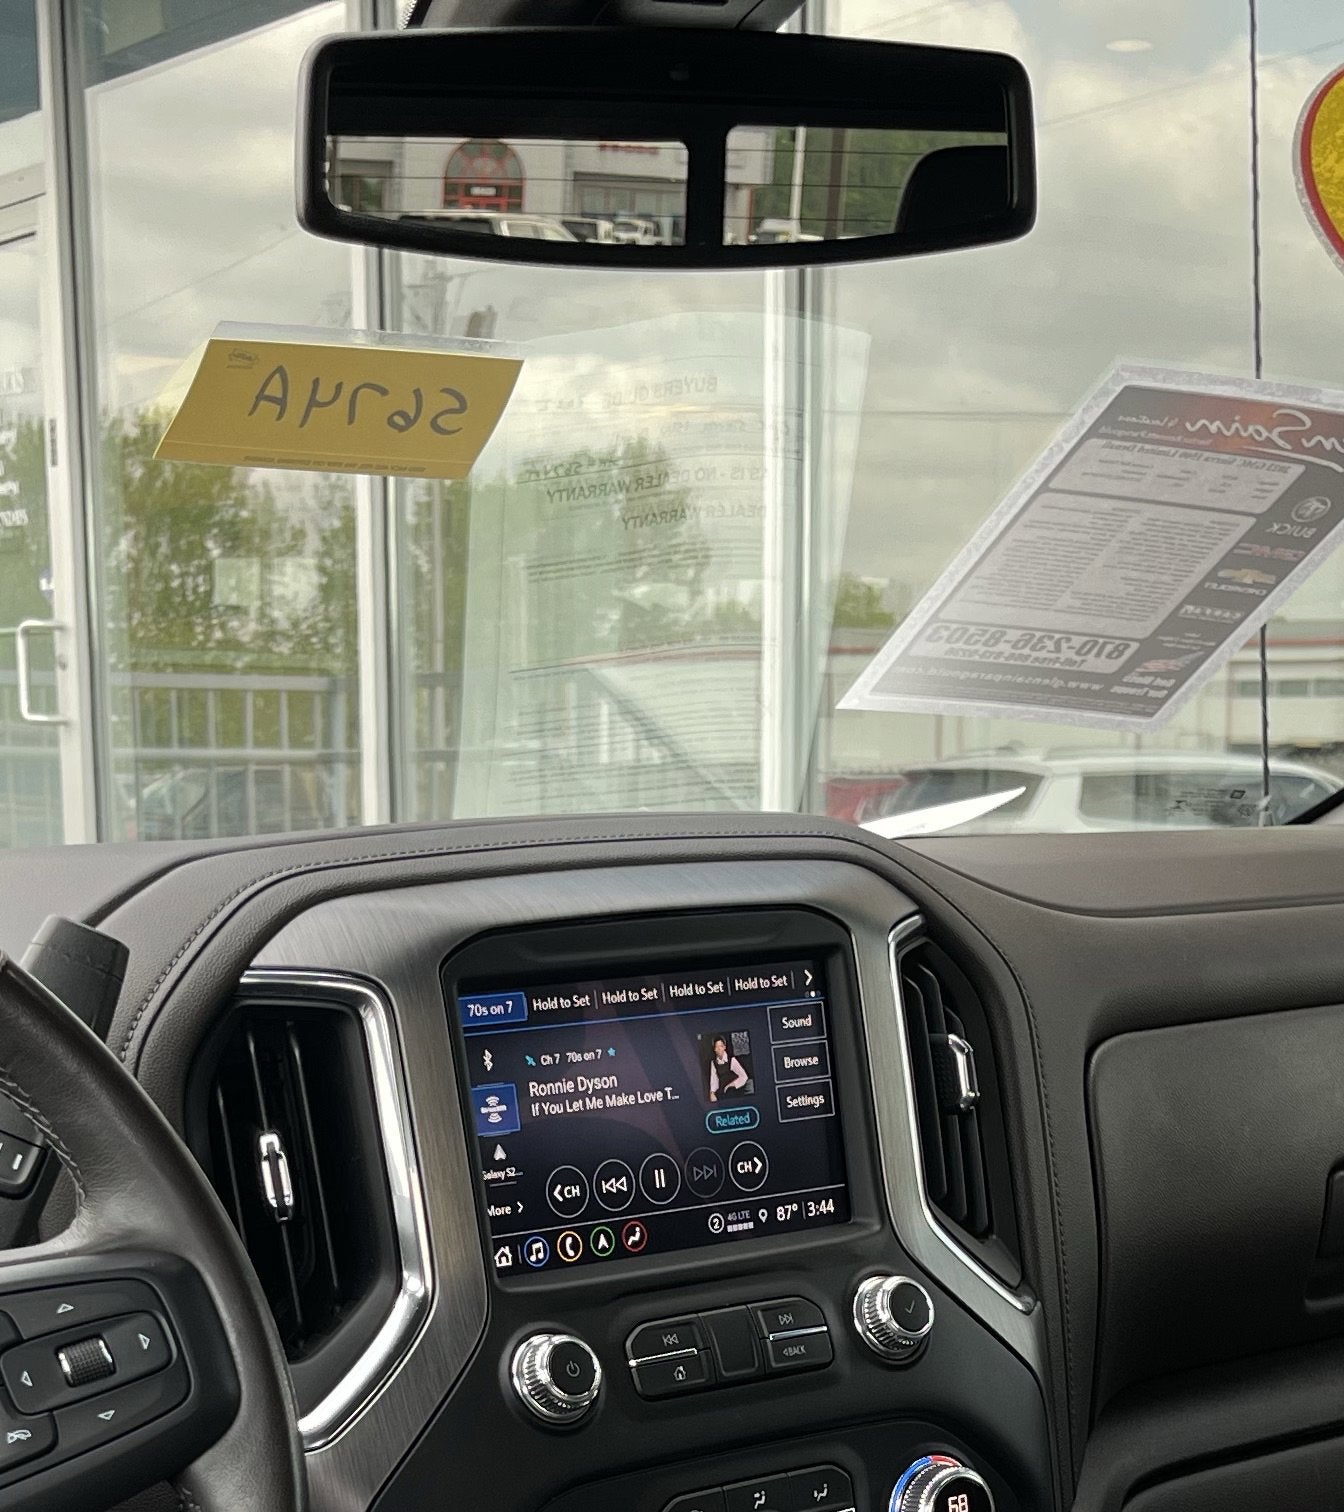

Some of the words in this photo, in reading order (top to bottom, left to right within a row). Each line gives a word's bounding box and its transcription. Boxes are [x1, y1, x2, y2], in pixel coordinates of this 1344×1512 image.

[669, 982, 694, 998] Hold
[695, 983, 706, 996] to
[706, 980, 724, 994] Set
[734, 976, 758, 991] Hold
[759, 976, 770, 989] to
[771, 975, 788, 988] Set
[532, 996, 558, 1012] Hold
[559, 997, 572, 1010] to
[573, 994, 591, 1008] Set
[601, 990, 627, 1005] Hold
[628, 990, 640, 1003] to
[640, 987, 658, 1001] Set
[467, 1003, 488, 1018] 70s
[490, 1003, 505, 1015] on
[505, 1000, 513, 1014] 7
[781, 1014, 812, 1029] Sound
[540, 1053, 554, 1066] Ch
[554, 1052, 561, 1065] 7
[583, 1050, 595, 1061] on
[595, 1048, 602, 1060] 7
[783, 1055, 819, 1069] Browse
[528, 1079, 575, 1098] Ronnie
[577, 1074, 618, 1095] Dyson
[530, 1103, 540, 1117] If
[540, 1101, 564, 1116] You
[565, 1098, 584, 1113] Let
[585, 1096, 604, 1110] Me
[605, 1092, 634, 1109] Make
[637, 1090, 663, 1104] Love
[785, 1093, 825, 1110] Settings
[715, 1113, 752, 1128] Related
[736, 1160, 754, 1175] CH
[563, 1184, 581, 1199] CH
[739, 1210, 751, 1220] LTE
[807, 1198, 835, 1217] 3:44
[787, 1344, 807, 1357] BACK
